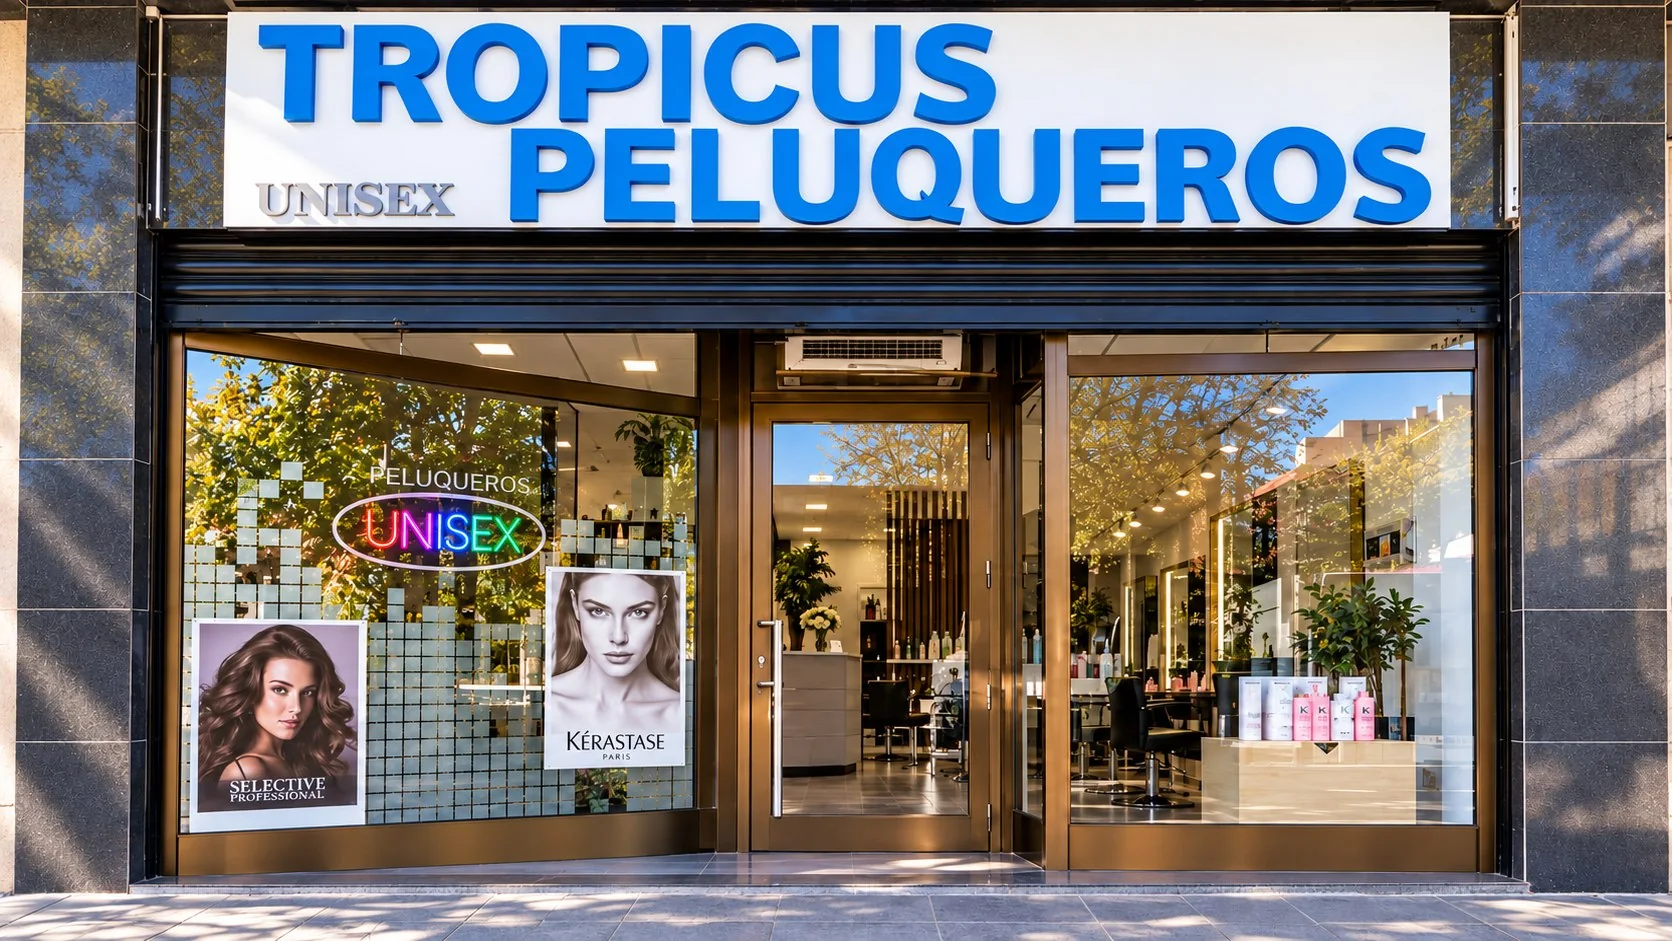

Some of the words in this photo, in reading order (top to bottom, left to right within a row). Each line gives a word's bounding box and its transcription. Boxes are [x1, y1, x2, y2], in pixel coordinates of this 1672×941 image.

[258, 22, 998, 125] TROPICUS
[509, 126, 1432, 225] PELUQUEROS
[255, 181, 455, 217] UNISEX
[370, 465, 531, 494] PELUQUEROS
[365, 509, 522, 554] UNISEX
[567, 730, 665, 751] KÉRASTASE
[602, 753, 631, 761] PARIS
[229, 777, 326, 794] SELECTIVE
[230, 790, 325, 803] PROFESSIONAL
